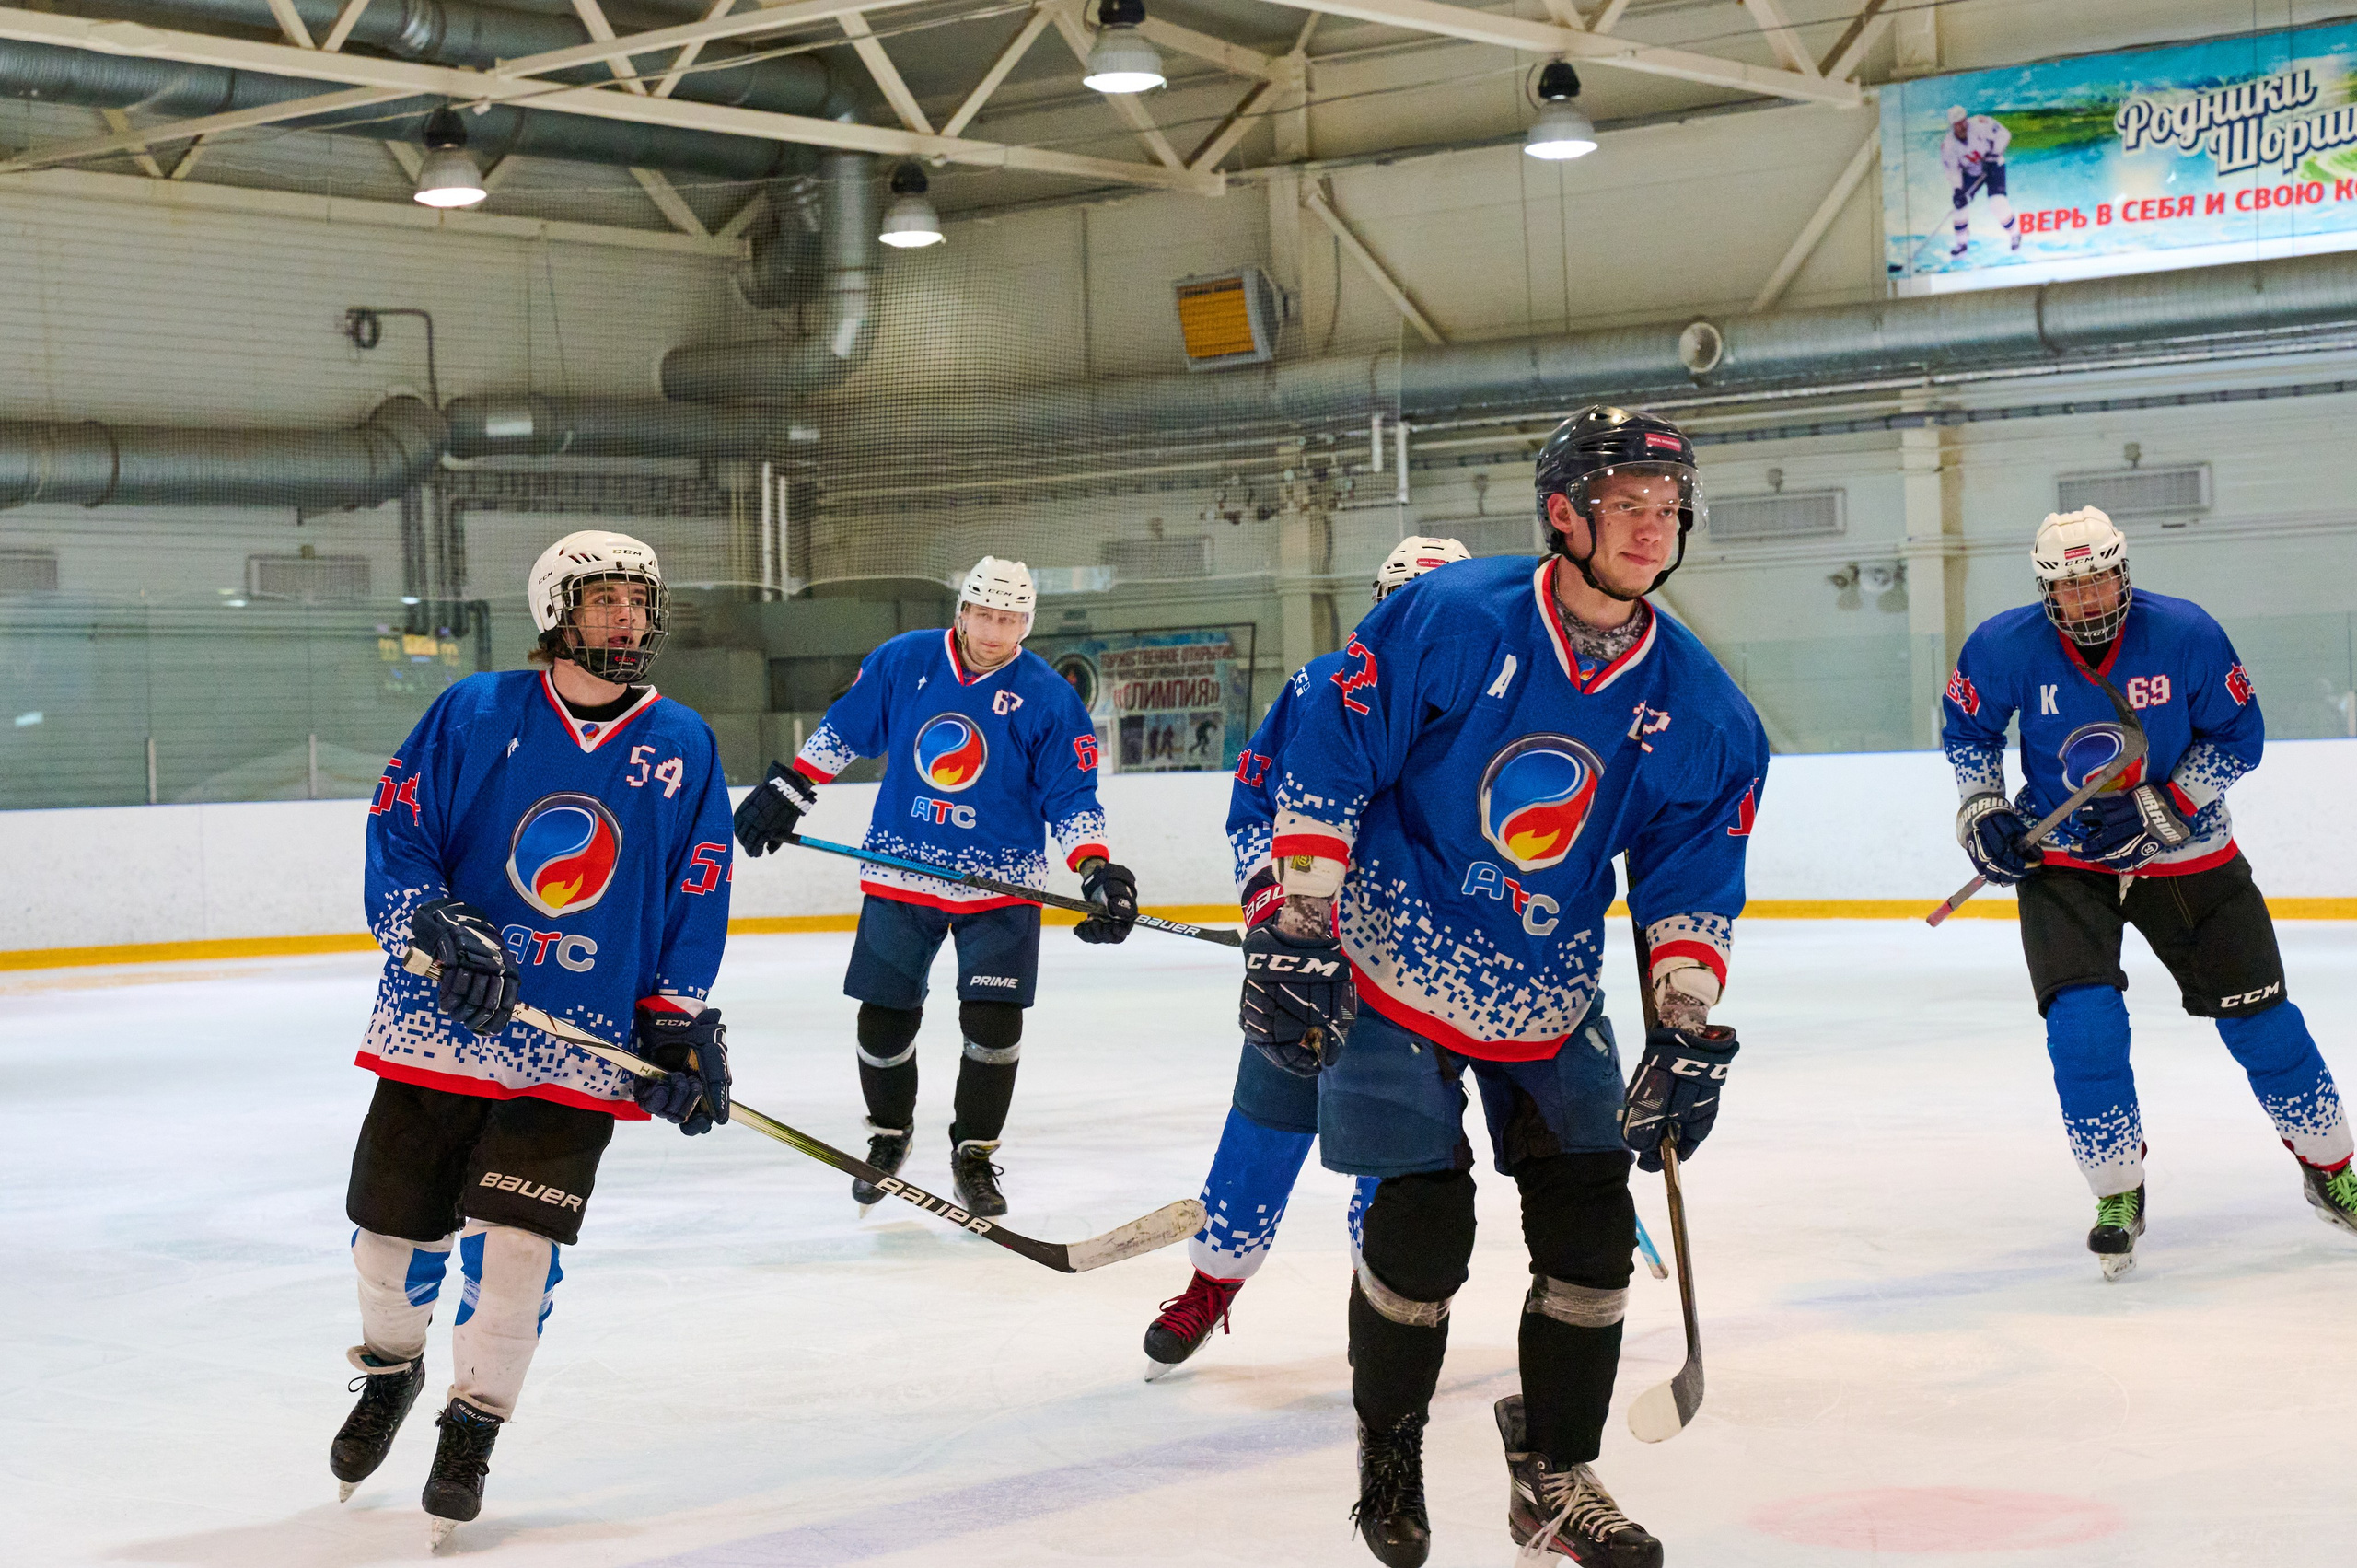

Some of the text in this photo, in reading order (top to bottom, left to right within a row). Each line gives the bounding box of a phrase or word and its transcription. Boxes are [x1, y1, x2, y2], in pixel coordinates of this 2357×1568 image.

[2118, 69, 2318, 151] Родники
[2019, 177, 2357, 236] ВЕРЬ В СЕБЯ И СВОЮ К
[612, 549, 642, 557] CCM
[2065, 556, 2095, 567] CCM
[538, 570, 553, 585] CCM
[988, 588, 1013, 597] CCM
[1329, 632, 1379, 716] 2
[2224, 662, 2256, 707] 6
[992, 689, 1024, 715] 67
[1945, 667, 1980, 717] 69
[2127, 674, 2172, 710] 69
[626, 745, 684, 799] 54
[1234, 748, 1272, 788] 17
[2136, 784, 2182, 842] WARRIOR
[681, 842, 734, 896] 5
[1134, 913, 1201, 937] BAUER
[1247, 952, 1341, 978] CCM
[969, 973, 1019, 990] PRIME
[2220, 981, 2281, 1009] CCM
[655, 1018, 691, 1028] CCM
[1670, 1056, 1732, 1080] CC
[479, 1171, 584, 1213] BAUER
[874, 1175, 993, 1237] BAUER
[456, 1402, 497, 1424] BAUER
